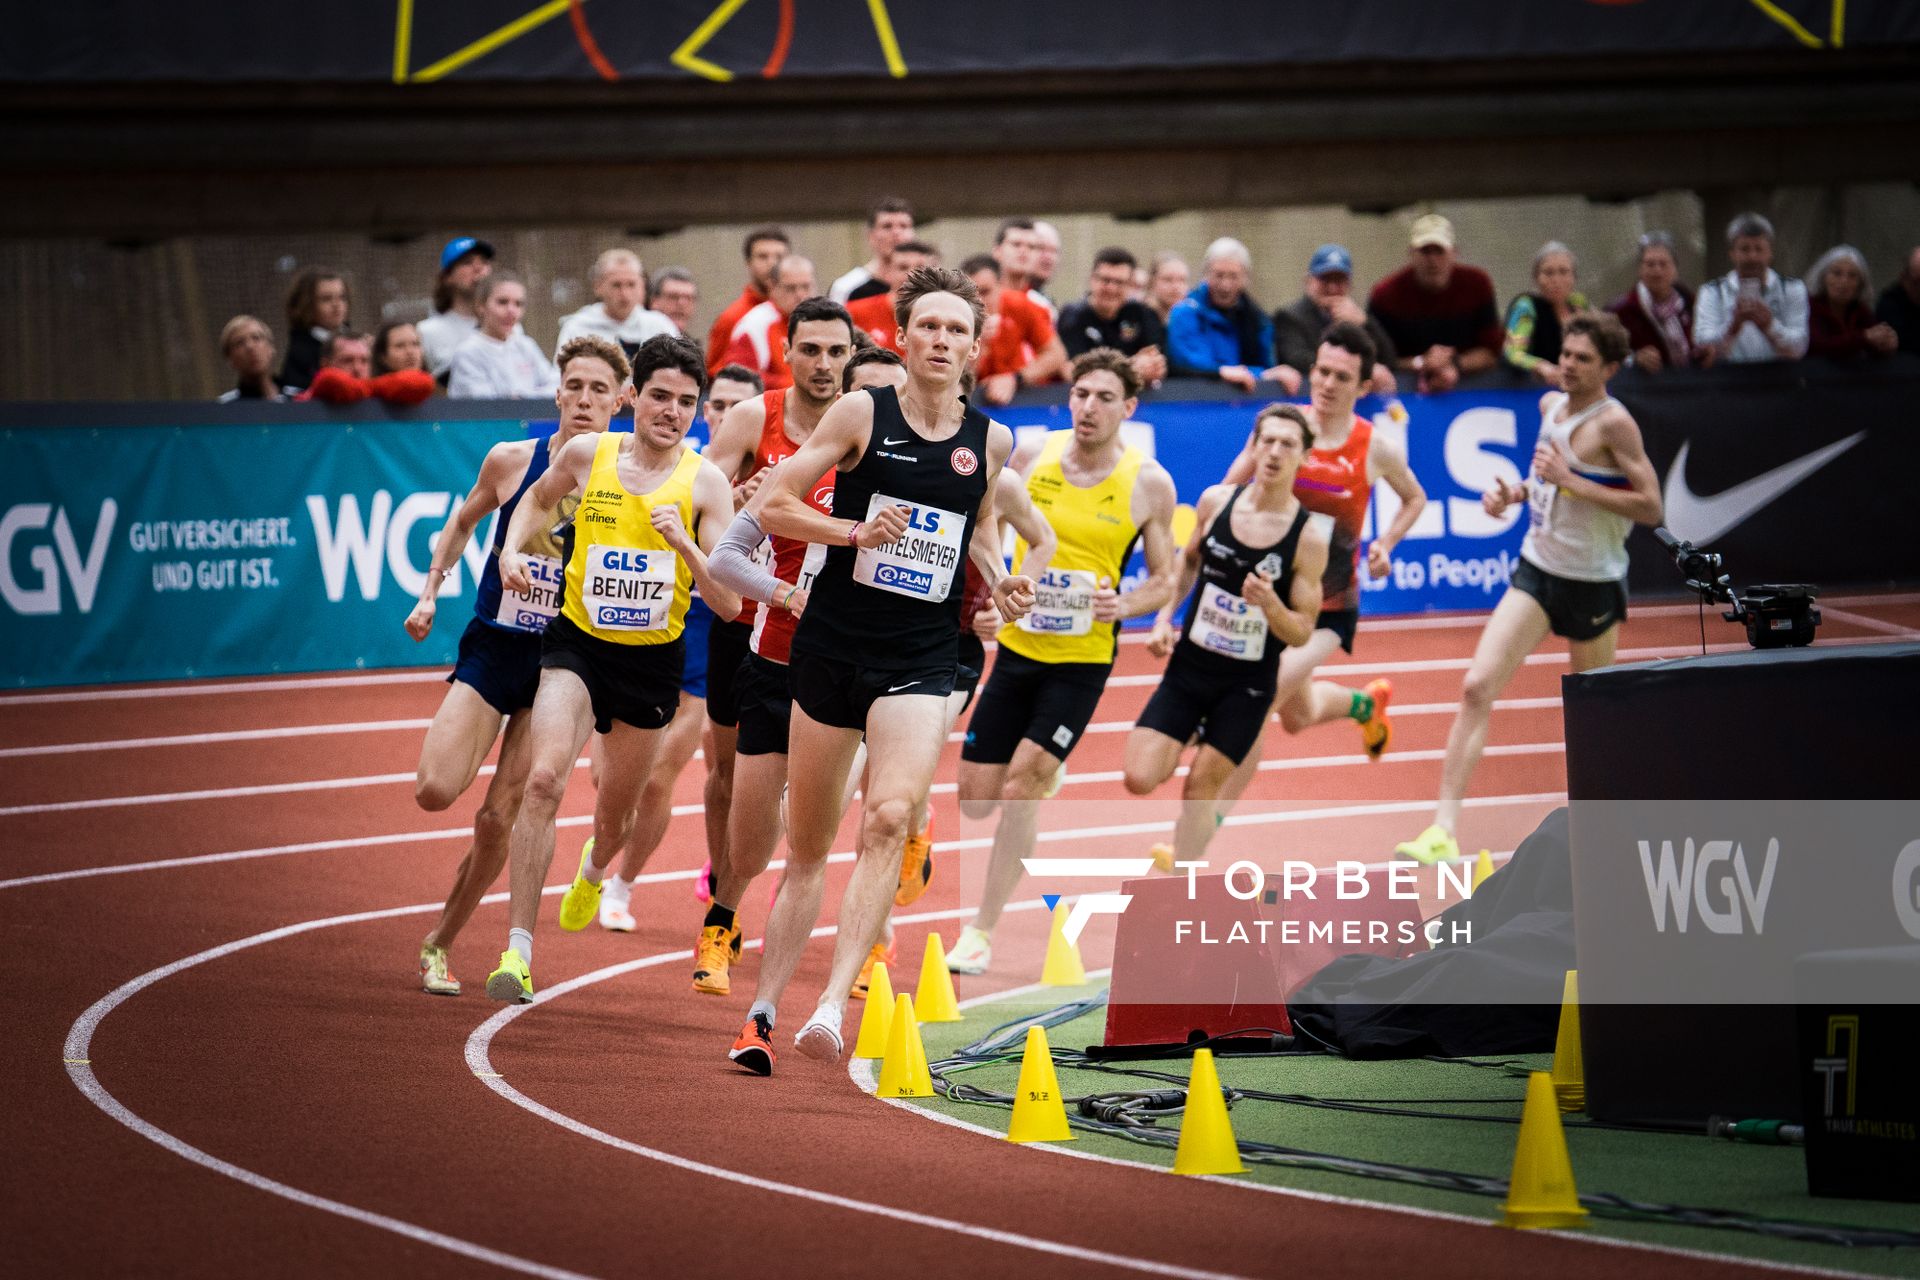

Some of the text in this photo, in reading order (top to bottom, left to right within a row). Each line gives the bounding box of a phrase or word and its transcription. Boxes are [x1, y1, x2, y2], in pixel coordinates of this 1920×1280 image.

[585, 512, 617, 524] infinex
[896, 504, 940, 533] LS
[129, 517, 297, 552] GUT VERSICHERT.
[152, 557, 279, 592] UND GUT IST.
[898, 571, 930, 587] PLAN
[1393, 557, 1425, 590] to
[592, 576, 664, 600] BENITZ
[620, 611, 649, 621] PLAN
[1201, 607, 1263, 635] BEIMLER
[1637, 836, 1780, 935] WGV
